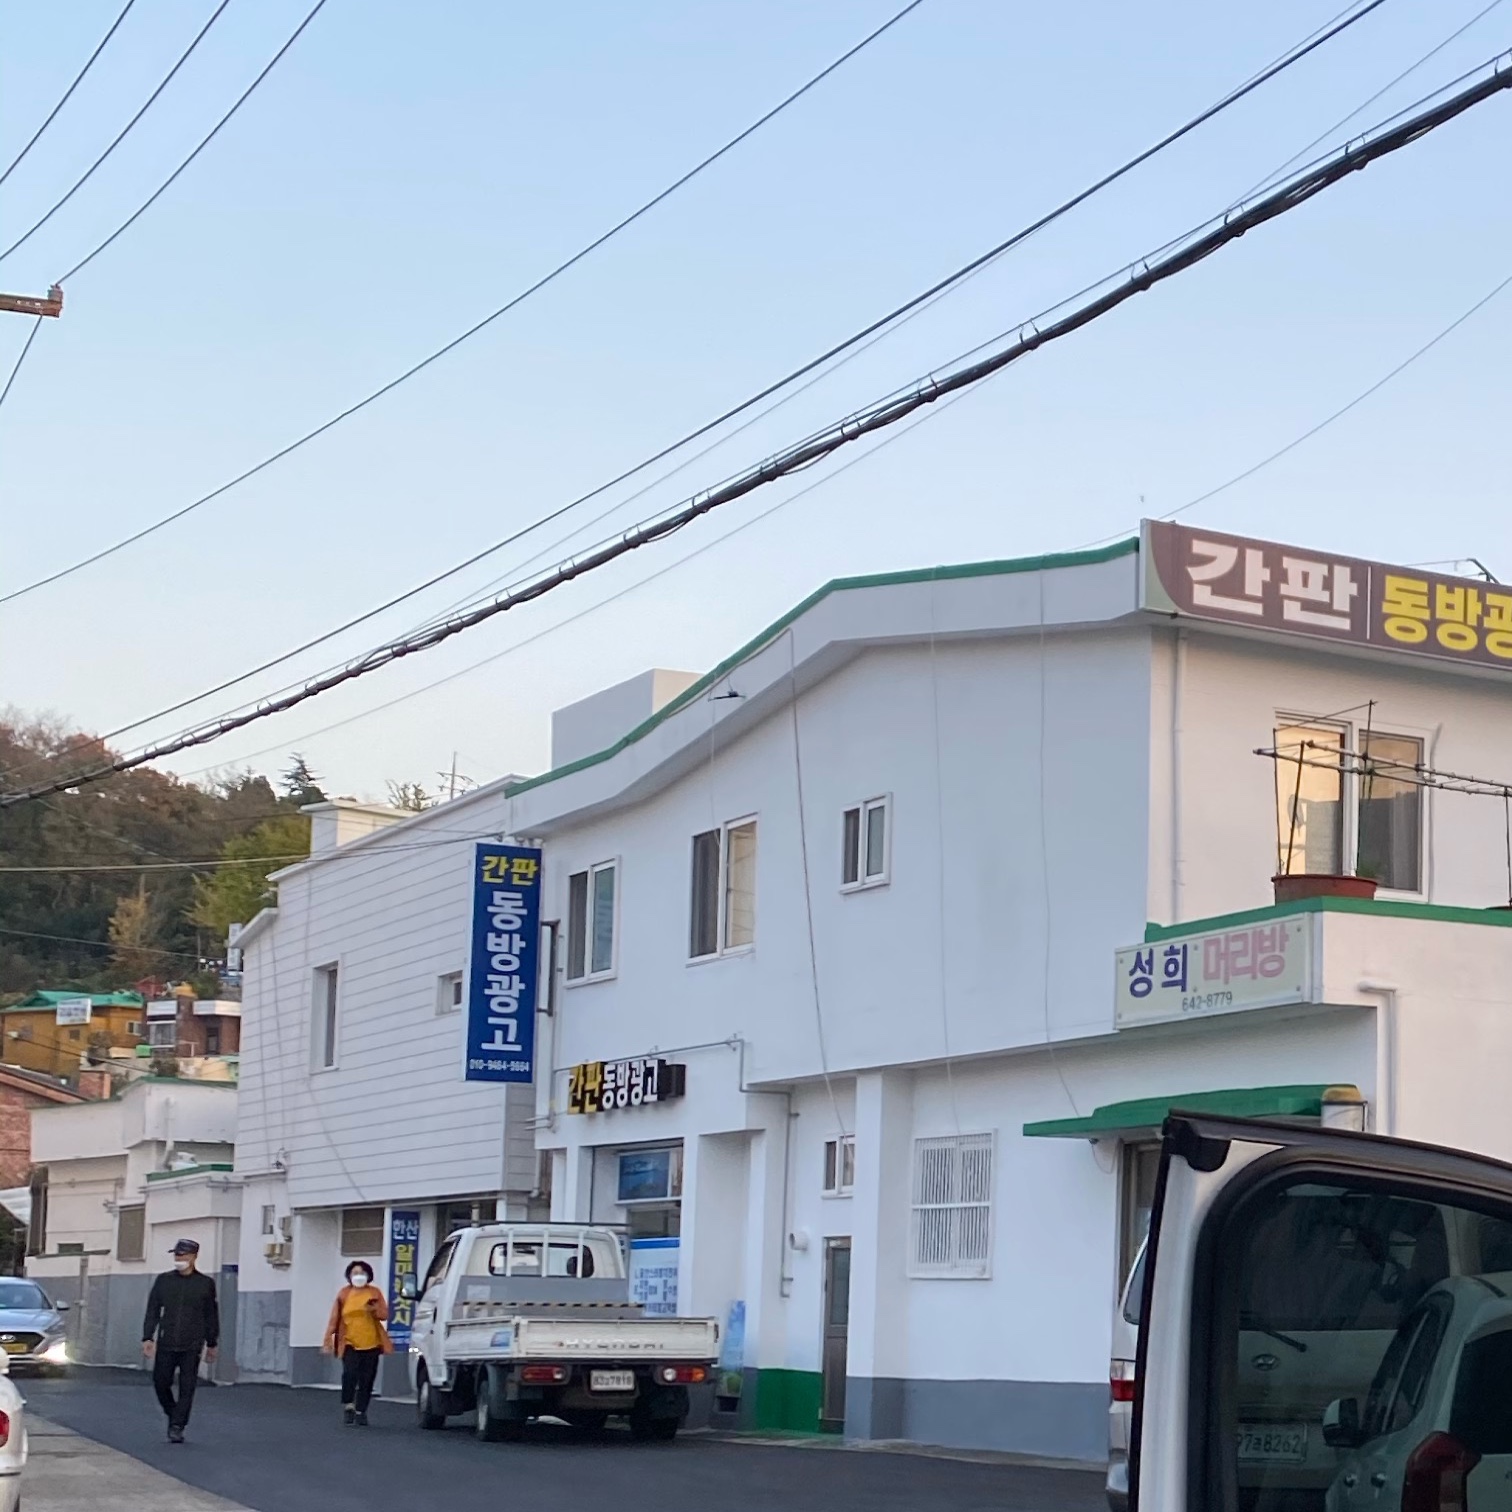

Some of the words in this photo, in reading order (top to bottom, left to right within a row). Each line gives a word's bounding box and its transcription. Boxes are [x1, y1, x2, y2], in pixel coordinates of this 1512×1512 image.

[1186, 538, 1358, 632] 간판
[481, 855, 539, 887] 간판
[480, 889, 528, 1053] 동방광고
[1128, 943, 1188, 999] 성희
[1203, 924, 1290, 986] 머리방
[1182, 991, 1233, 1012] 642-8779
[567, 1061, 602, 1115] 간판
[602, 1060, 658, 1110] 동방광고
[392, 1218, 419, 1240] 한산
